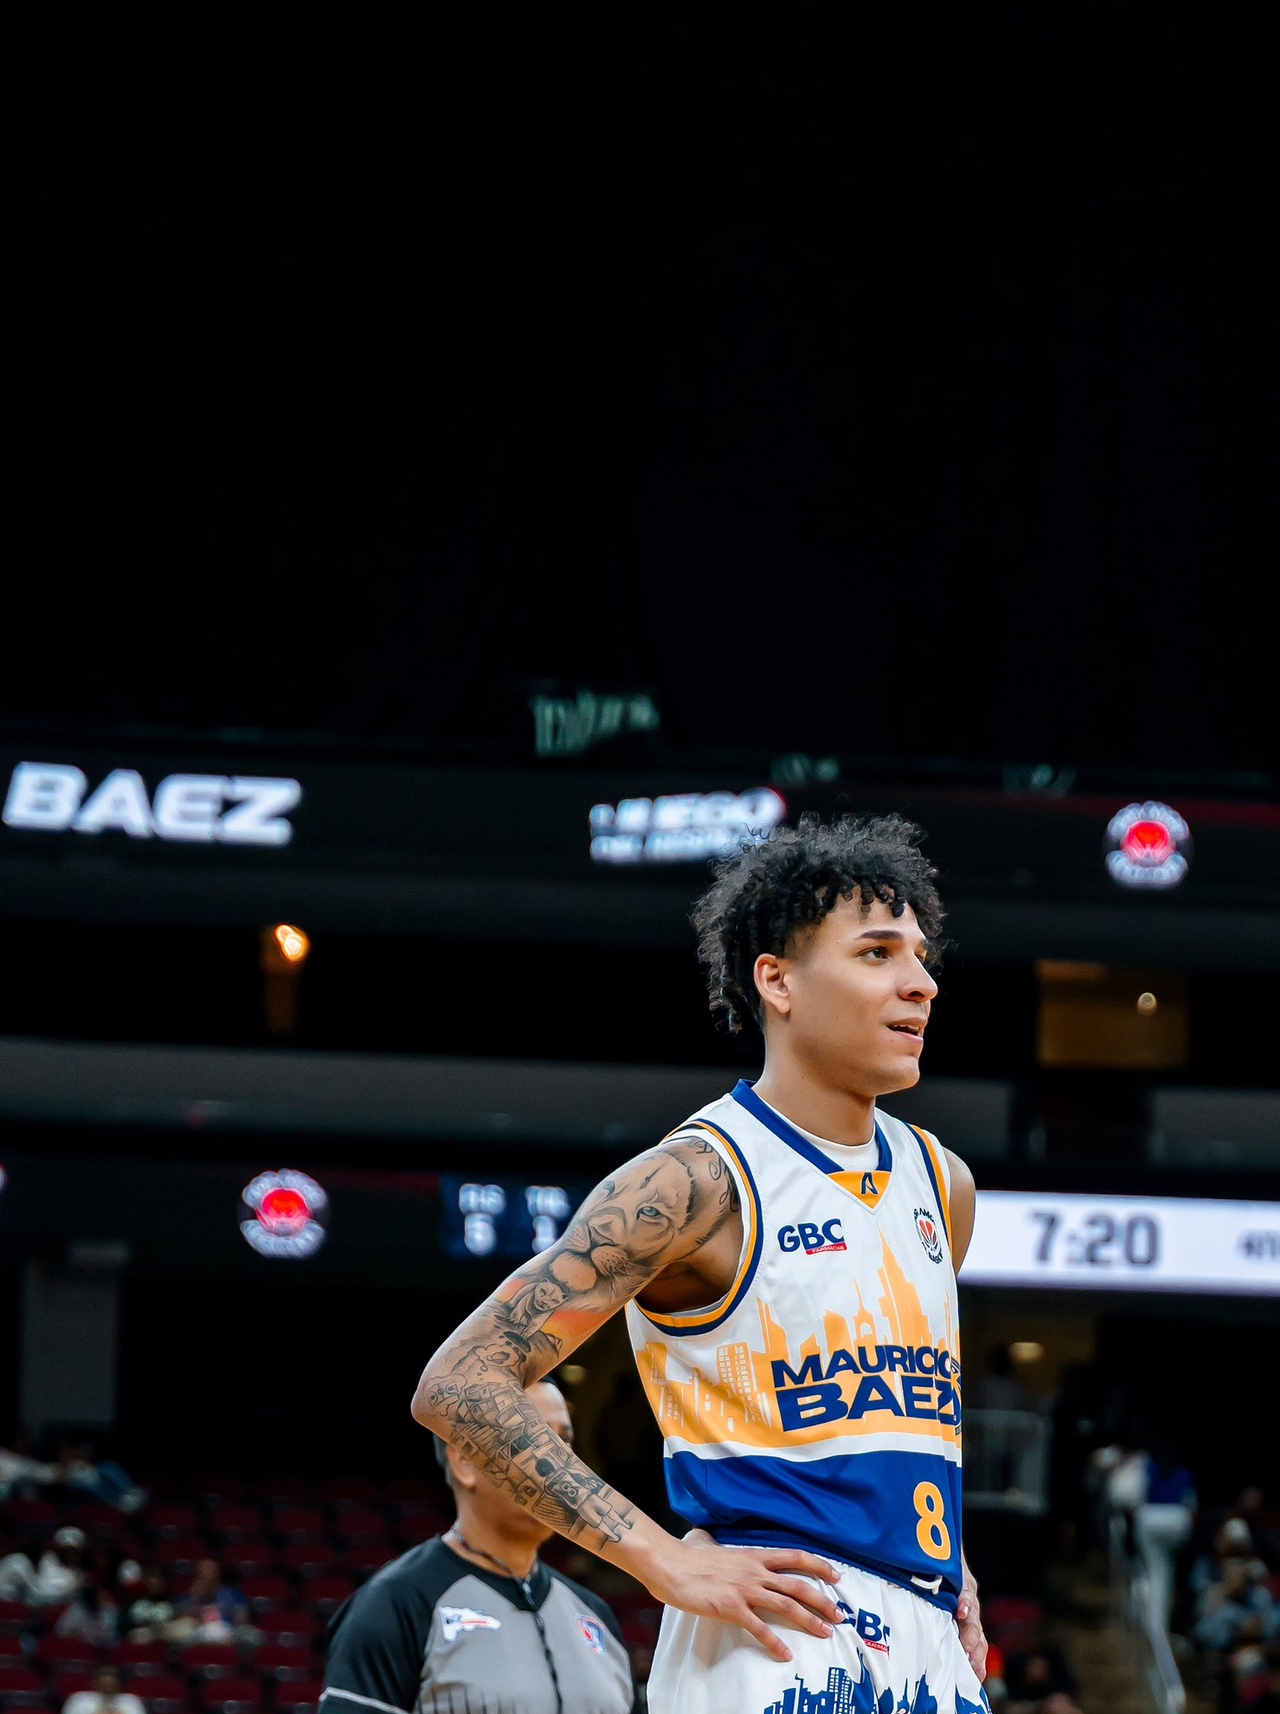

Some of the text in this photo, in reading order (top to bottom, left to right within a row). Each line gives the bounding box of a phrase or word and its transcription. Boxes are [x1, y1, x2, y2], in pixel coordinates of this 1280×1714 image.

[3, 761, 301, 846] BAEZ
[777, 1218, 845, 1253] GBC
[1028, 1209, 1160, 1269] 7:20
[775, 1375, 961, 1432] BAEZ
[912, 1481, 951, 1561] 8
